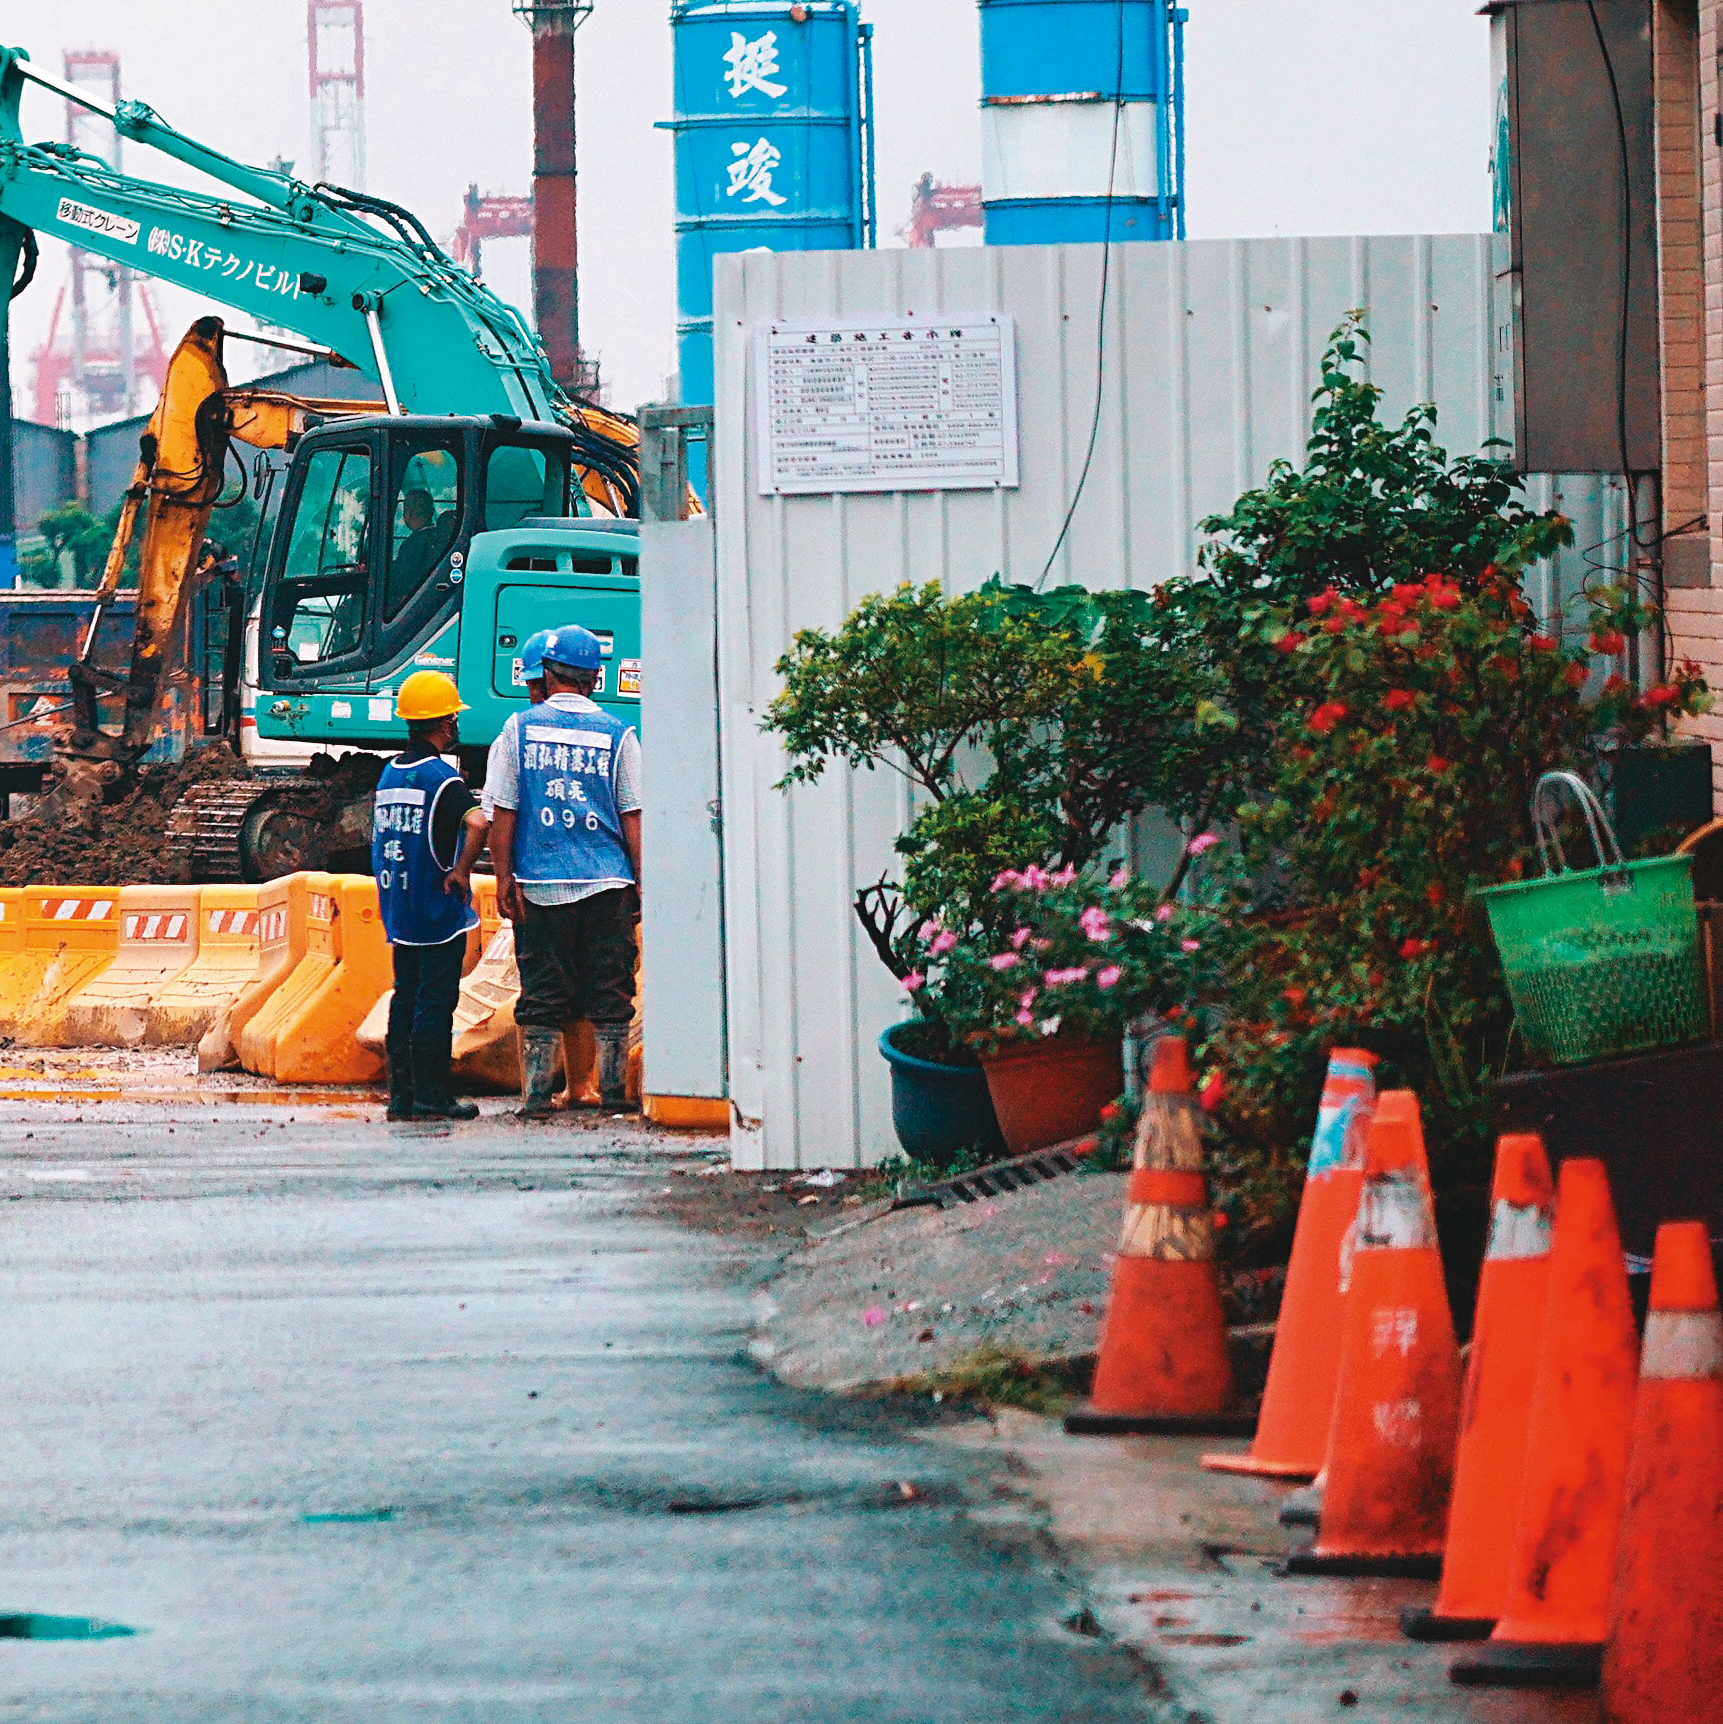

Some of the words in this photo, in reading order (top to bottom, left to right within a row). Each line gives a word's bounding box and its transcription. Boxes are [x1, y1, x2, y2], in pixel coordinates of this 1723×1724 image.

[723, 30, 788, 253] 挺竣
[59, 200, 139, 240] 移動式クレーン
[540, 806, 599, 831] 096
